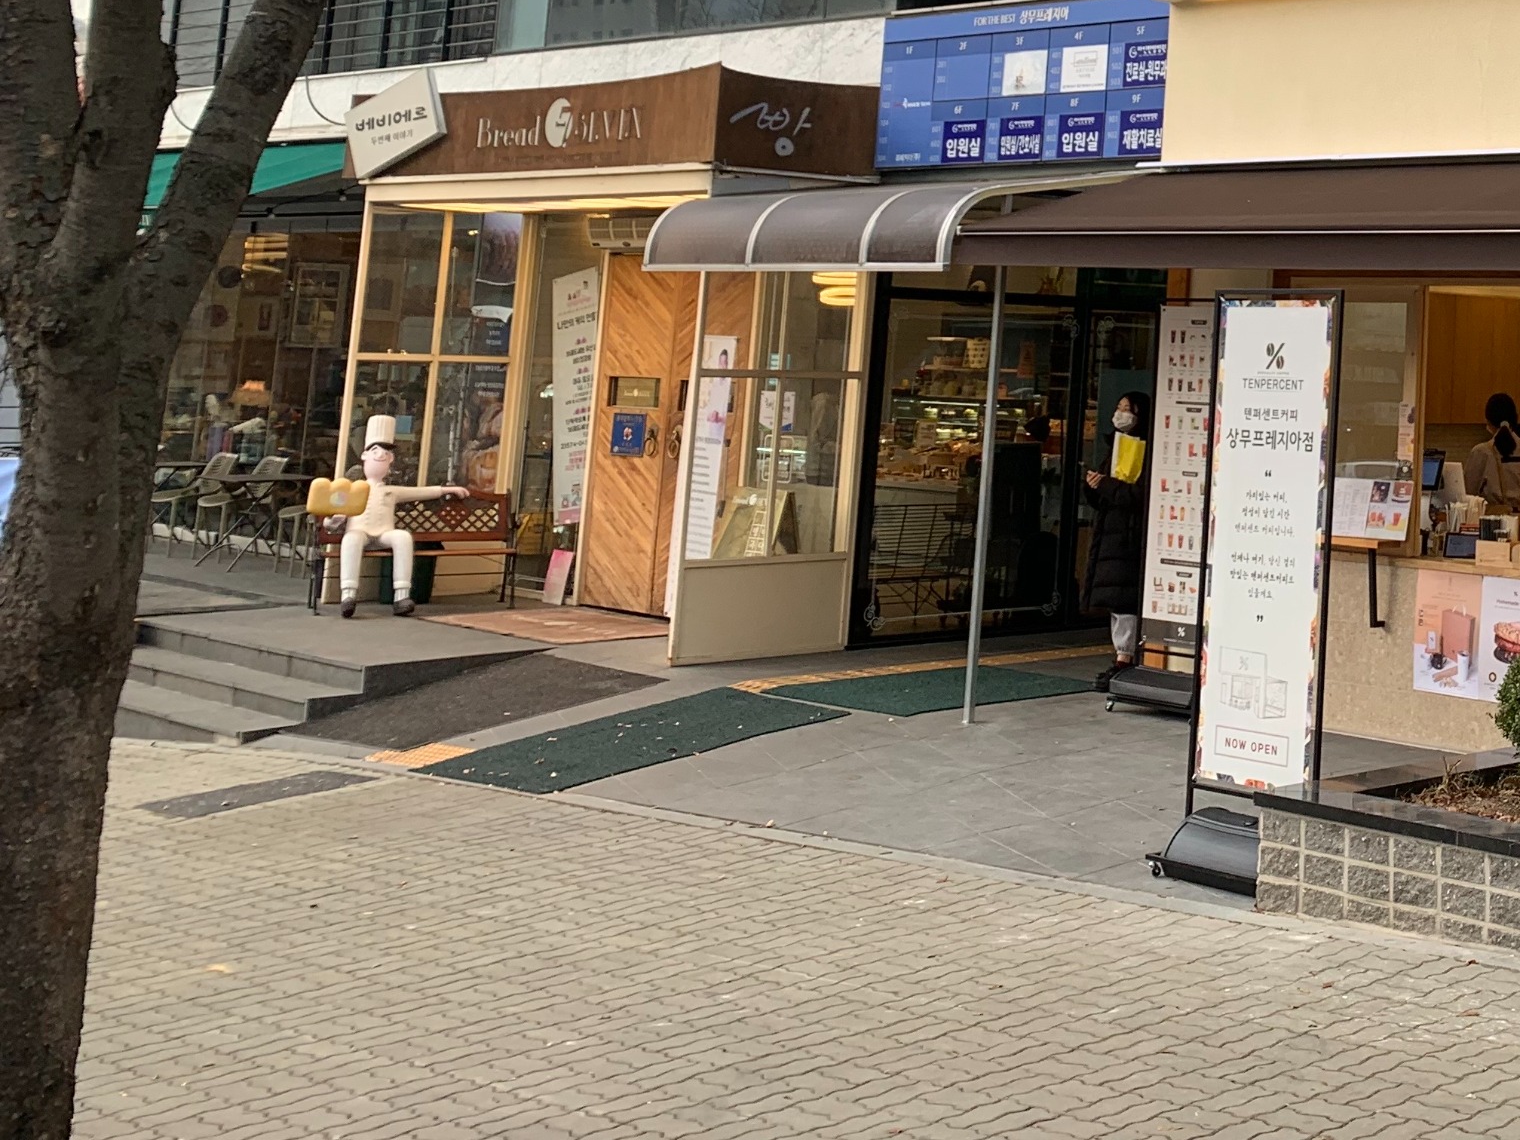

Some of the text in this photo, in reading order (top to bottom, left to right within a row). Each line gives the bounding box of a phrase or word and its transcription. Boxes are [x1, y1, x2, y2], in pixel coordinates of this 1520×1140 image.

[1000, 13, 1016, 24] BEST
[1019, 6, 1069, 24] 상무프레지아
[1074, 31, 1084, 41] 4F
[1136, 26, 1146, 36] 5F
[958, 41, 968, 51] 2F
[1015, 36, 1024, 46] 3F
[906, 46, 914, 55] 1F
[1070, 98, 1079, 107] 8F
[1131, 94, 1141, 103] 9F
[954, 105, 963, 114] 6F
[1011, 101, 1020, 111] 7F
[355, 106, 428, 132] 베비에르
[476, 115, 542, 149] Bread
[946, 137, 981, 158] 입원실
[1062, 131, 1099, 153] 입원실
[1242, 378, 1304, 391] TENPERCENT
[1244, 407, 1298, 422] 텐퍼센트커피
[1226, 428, 1314, 452] 상무프레지아점
[1224, 737, 1278, 756] NOW OPEN
